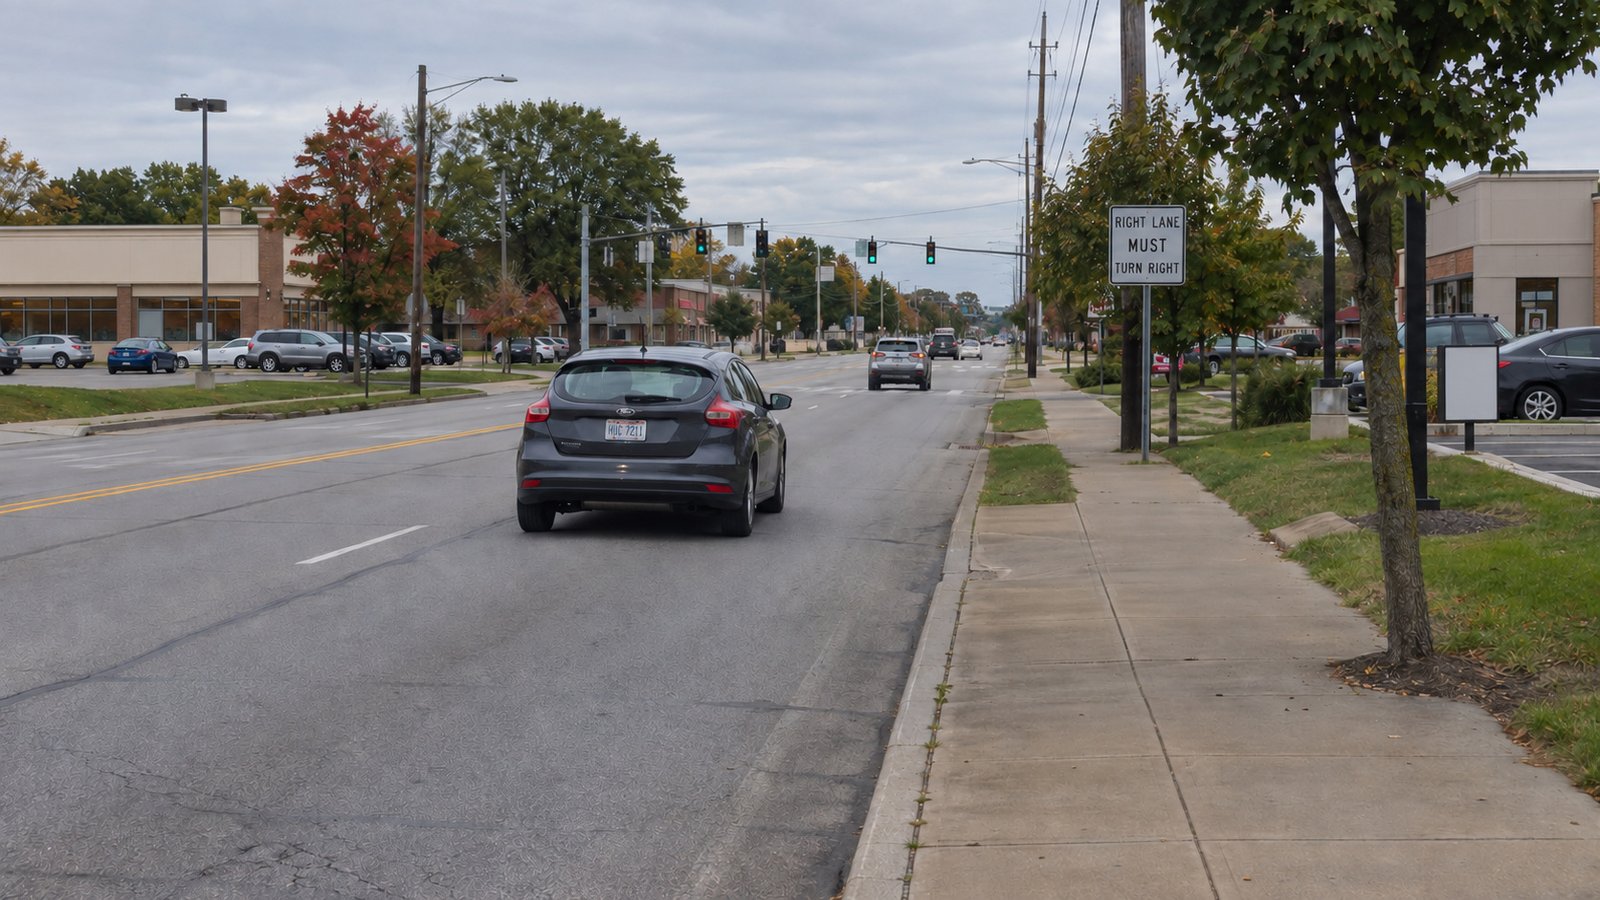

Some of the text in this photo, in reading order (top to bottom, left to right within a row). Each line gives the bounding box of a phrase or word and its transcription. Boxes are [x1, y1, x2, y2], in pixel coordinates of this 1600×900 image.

[1115, 216, 1180, 229] RIGHT LANE
[1128, 238, 1167, 253] MUST
[1115, 262, 1179, 274] TURN RIGHT
